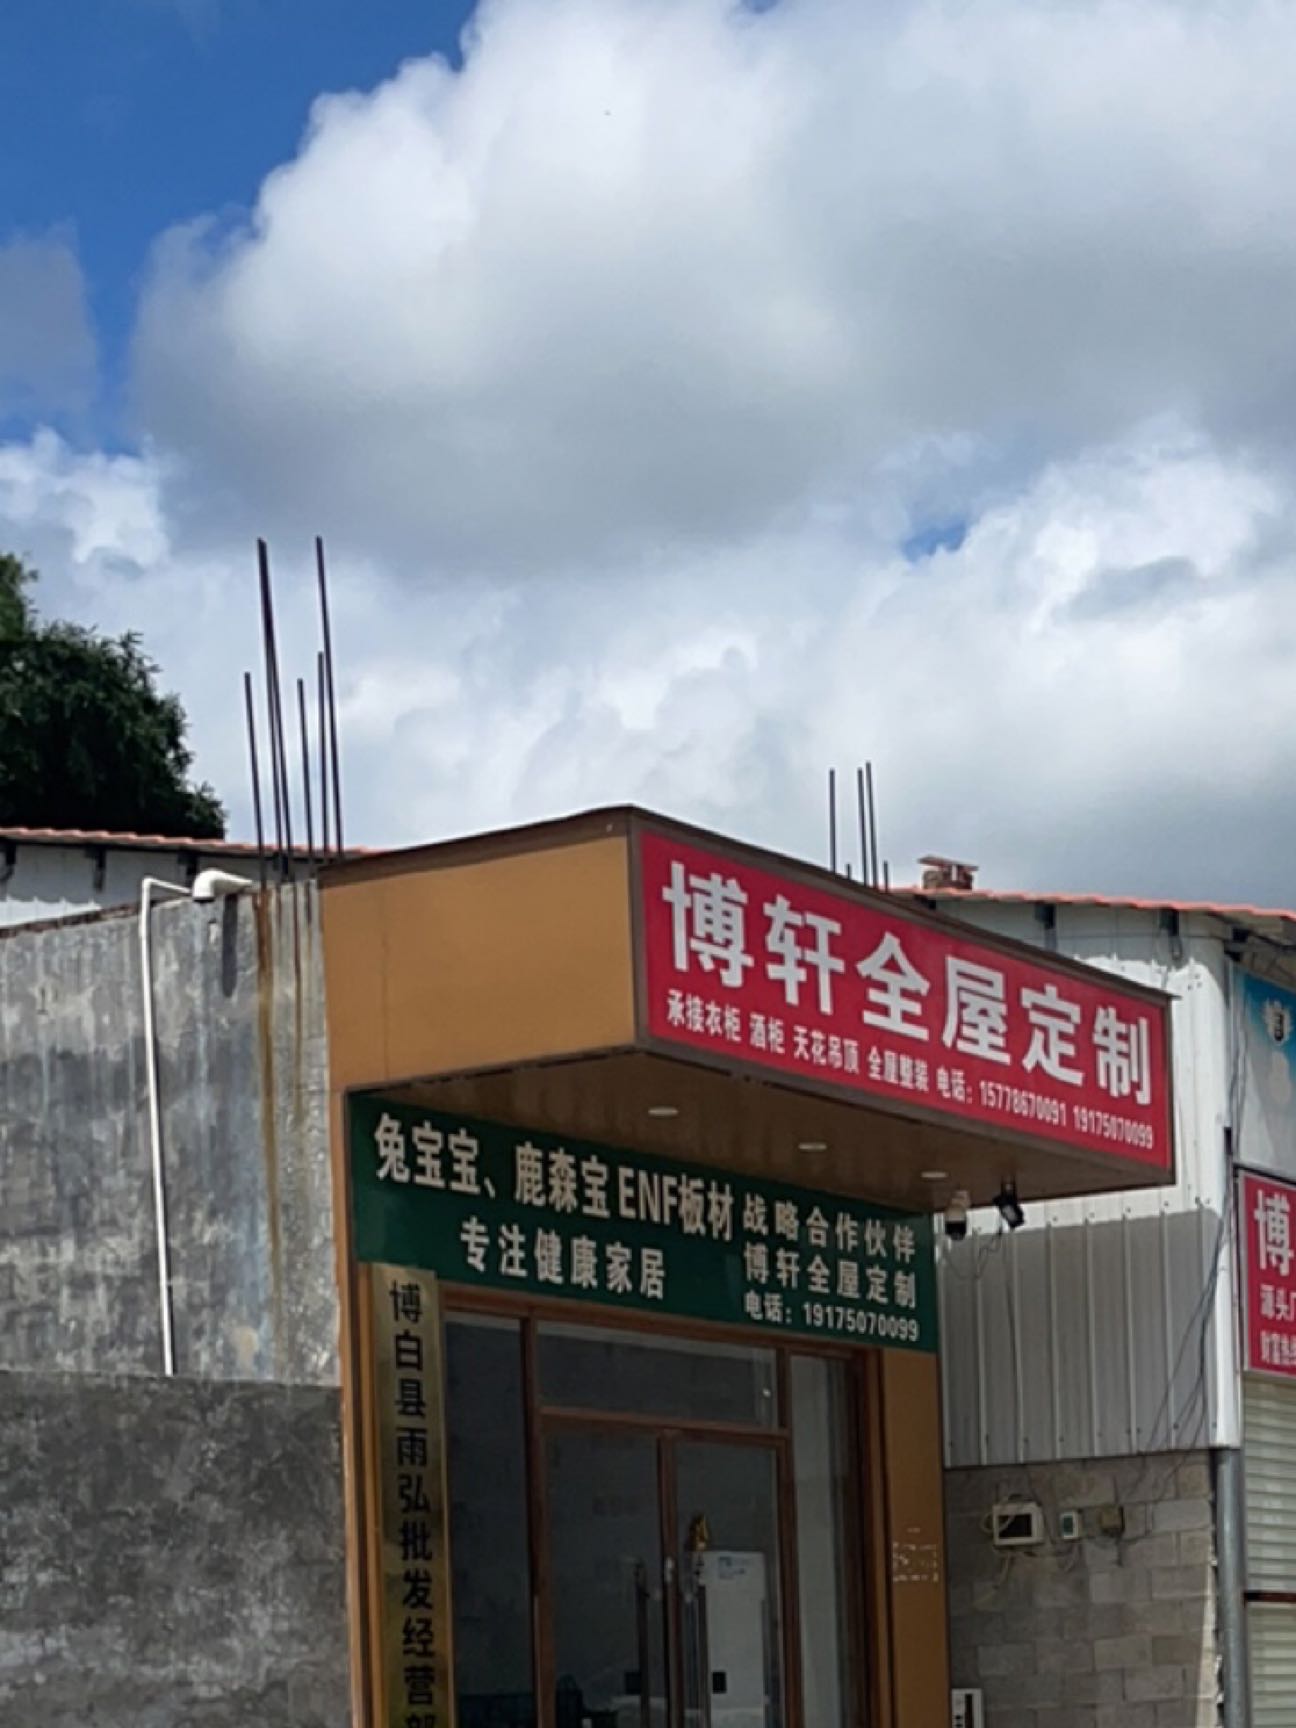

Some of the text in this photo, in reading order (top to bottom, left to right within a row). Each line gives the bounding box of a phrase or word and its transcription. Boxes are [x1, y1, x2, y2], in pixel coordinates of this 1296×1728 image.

[662, 860, 1151, 1105] 博轩全屋定制
[667, 989, 741, 1042] 承接衣柜
[749, 1012, 785, 1054] 酒柜
[793, 1025, 860, 1074] 天花吊顶
[460, 1216, 666, 1301] 专注健康家居
[743, 1195, 916, 1262] 战略合作伙伴
[744, 1242, 916, 1308] 博轩全屋定制
[802, 1301, 920, 1342] 19175070099
